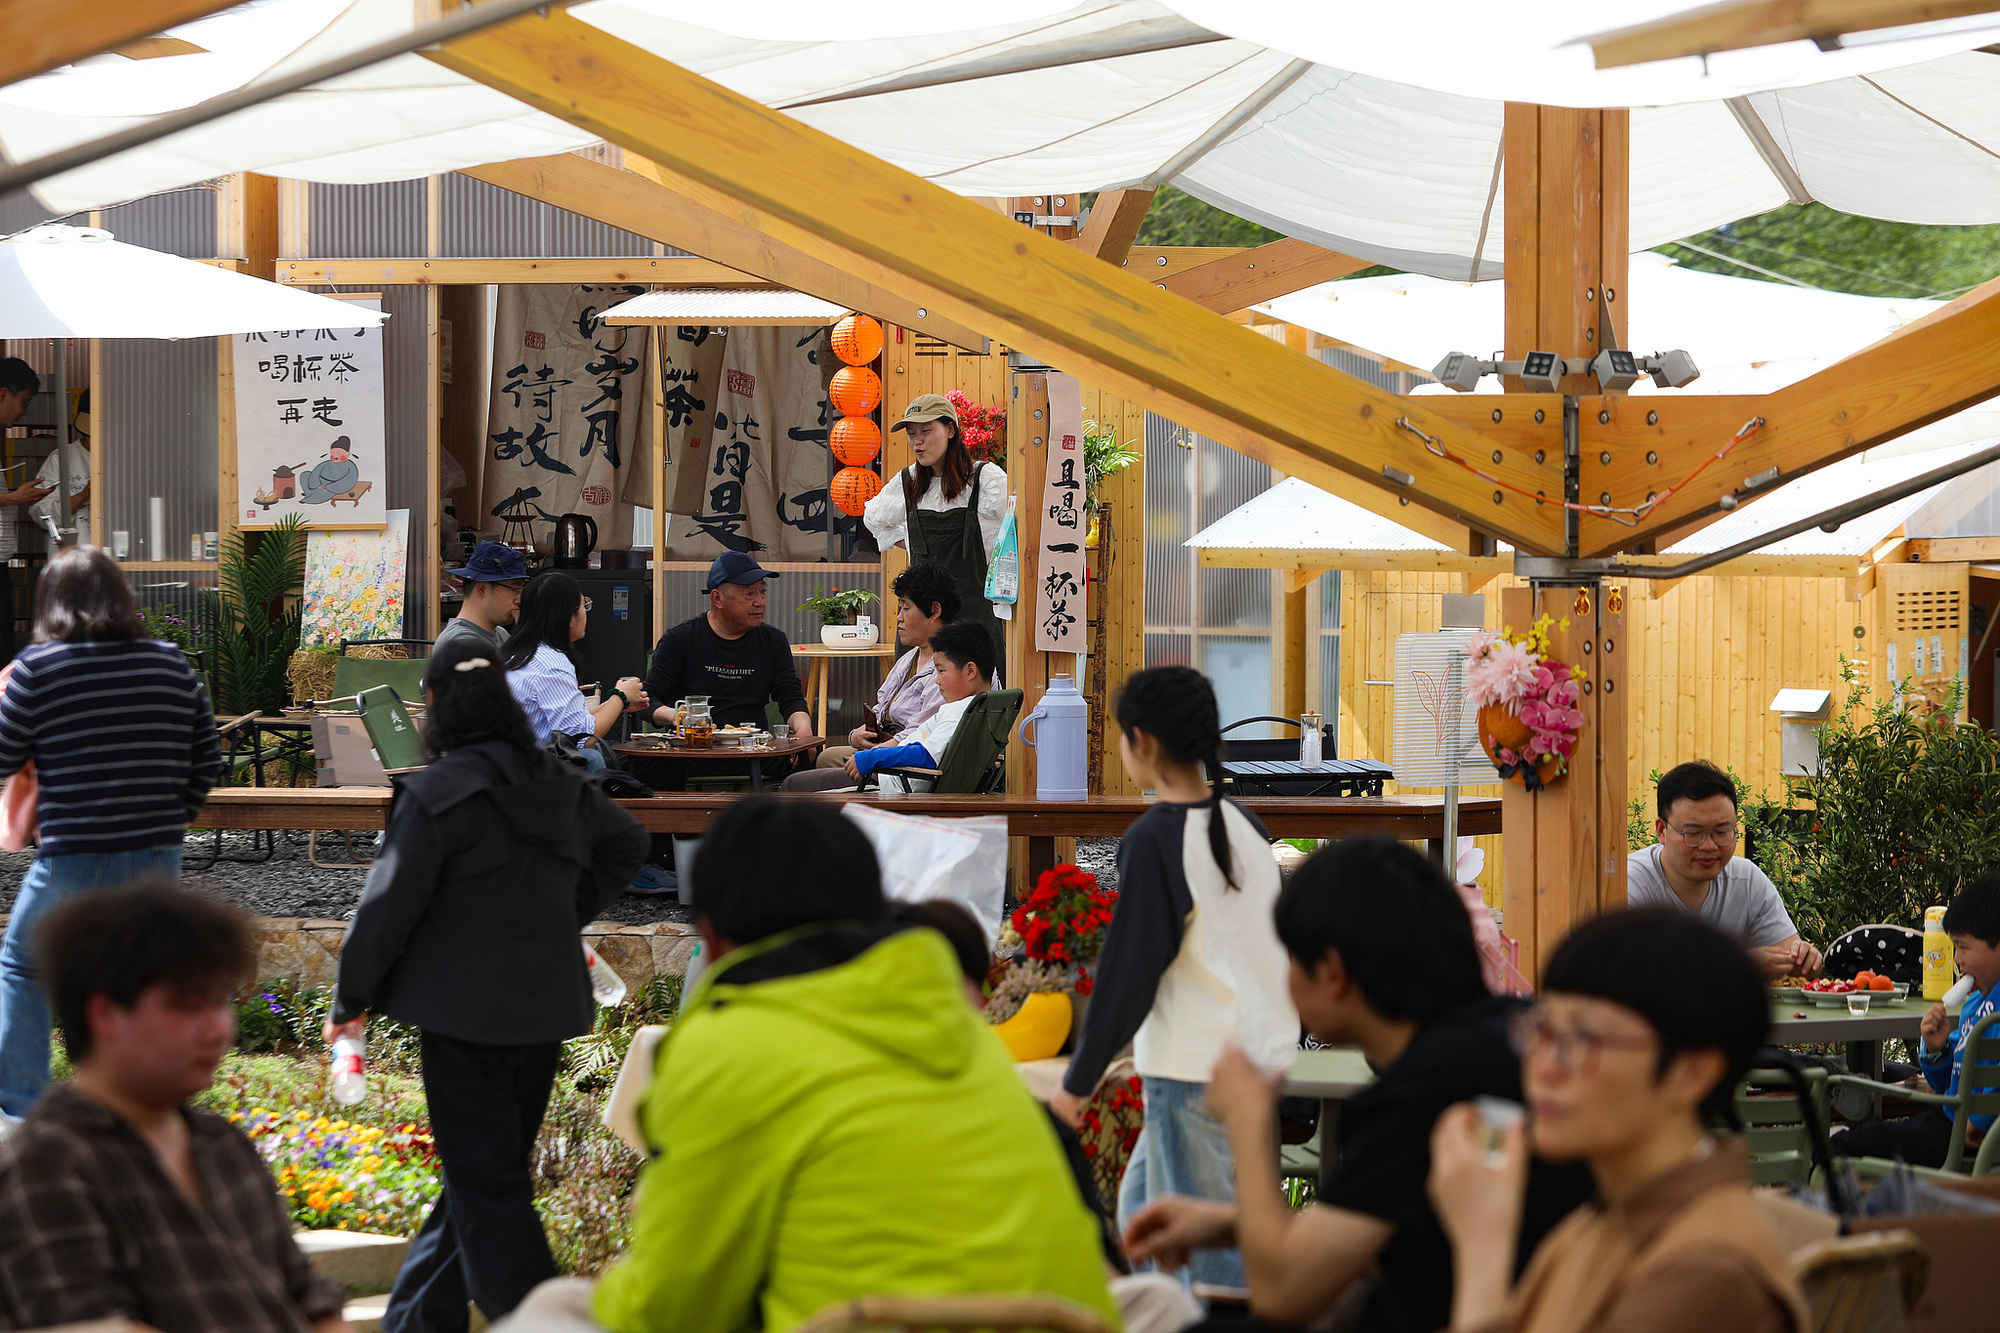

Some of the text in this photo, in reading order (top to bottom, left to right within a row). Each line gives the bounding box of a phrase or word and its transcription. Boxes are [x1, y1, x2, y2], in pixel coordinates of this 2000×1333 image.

[258, 352, 360, 384] 喝杯茶
[277, 397, 343, 427] 再走
[1043, 458, 1081, 642] 且喝一杯茶
